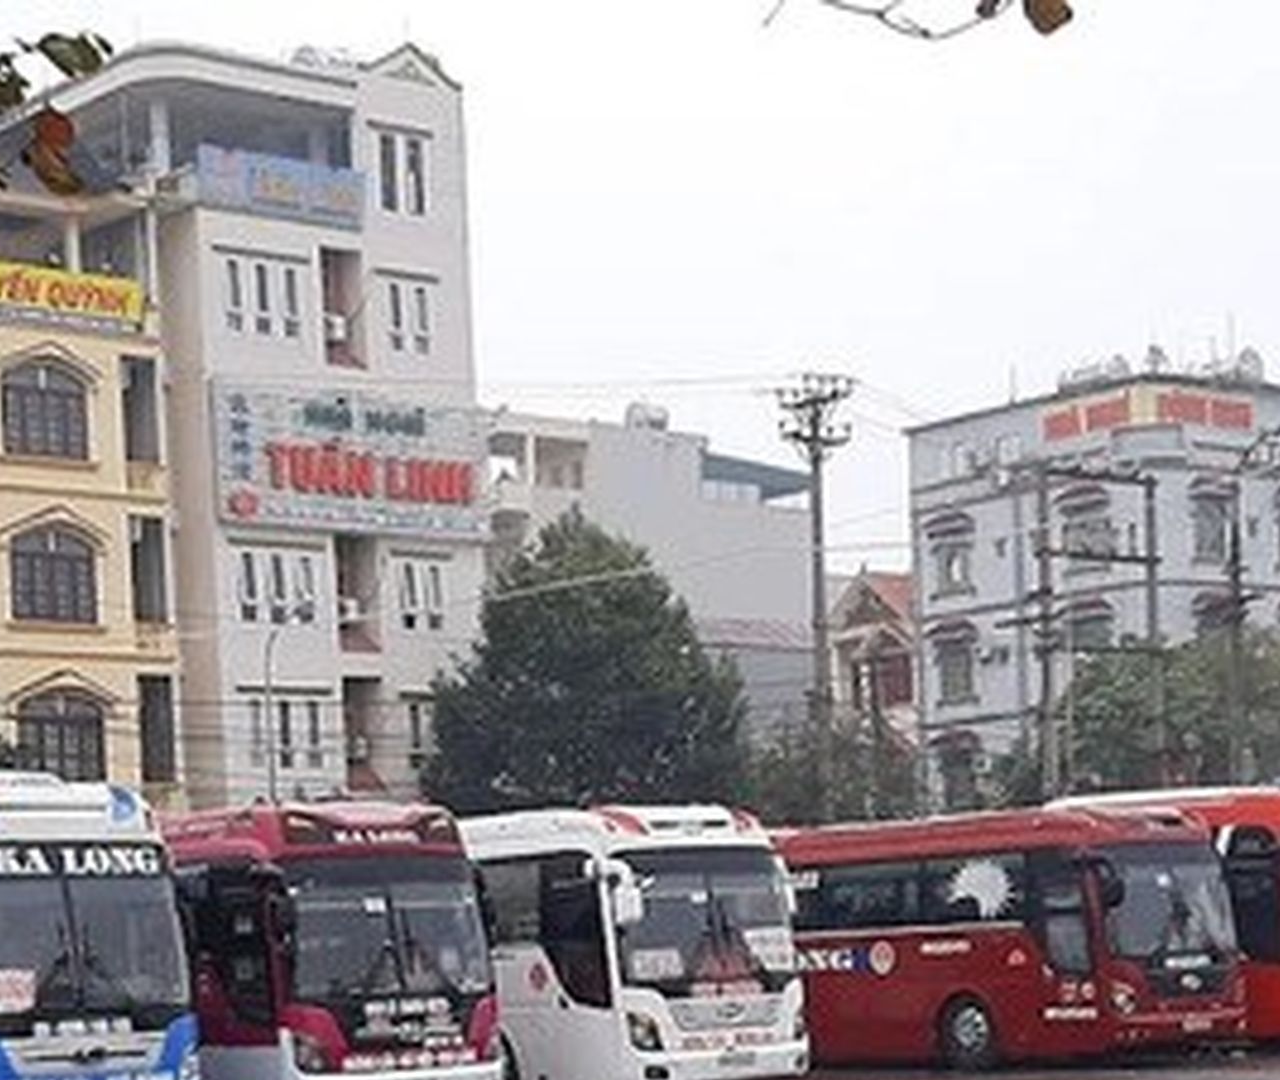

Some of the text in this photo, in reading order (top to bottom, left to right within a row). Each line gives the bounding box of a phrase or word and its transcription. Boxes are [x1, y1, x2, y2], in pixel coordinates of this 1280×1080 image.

[264, 437, 375, 499] TUẤN
[383, 456, 476, 506] LINH
[60, 846, 159, 874] LONG
